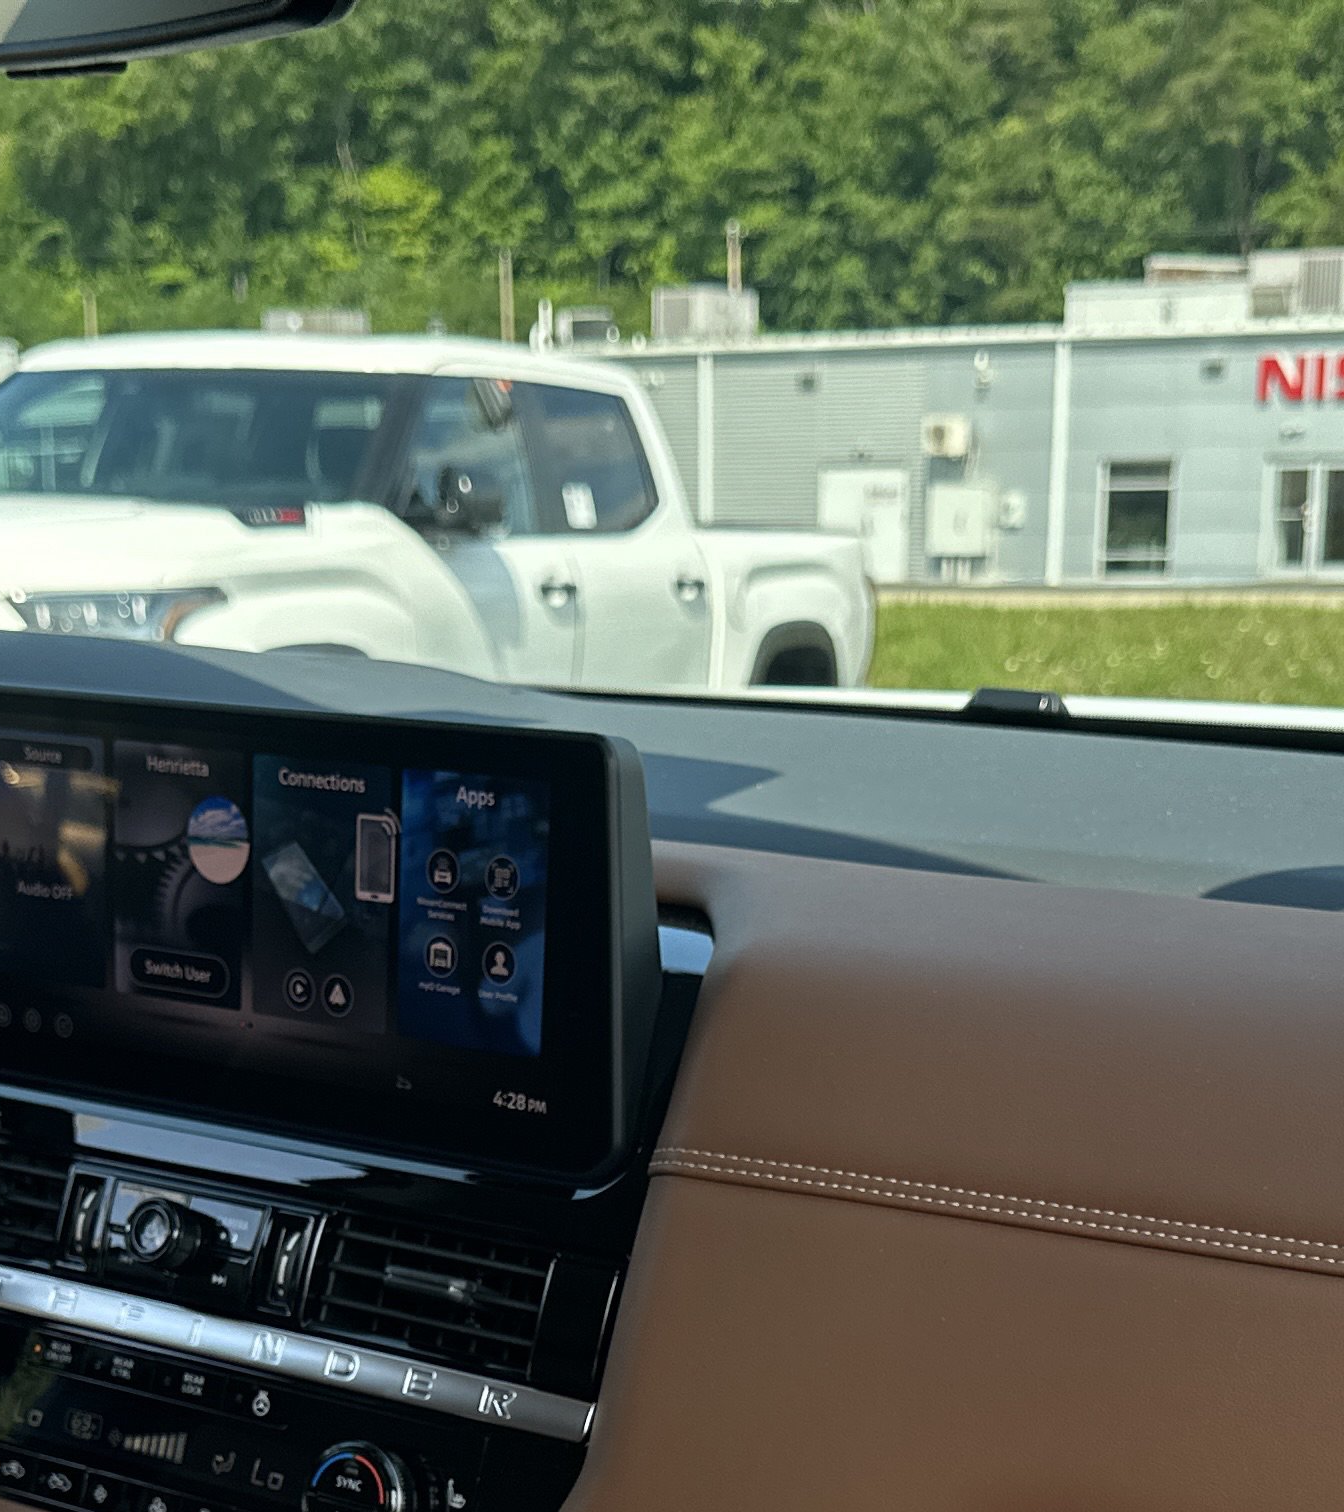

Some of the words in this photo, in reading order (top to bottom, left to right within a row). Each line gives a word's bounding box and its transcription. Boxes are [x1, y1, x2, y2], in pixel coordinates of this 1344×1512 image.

[145, 753, 211, 778] Henrietta
[277, 767, 366, 794] Connections
[456, 785, 496, 810] Apps
[143, 958, 181, 979] Switch
[183, 965, 212, 984] User
[492, 1090, 527, 1112] 4:28
[527, 1098, 548, 1115] PM
[335, 1473, 363, 1494] SYNC
